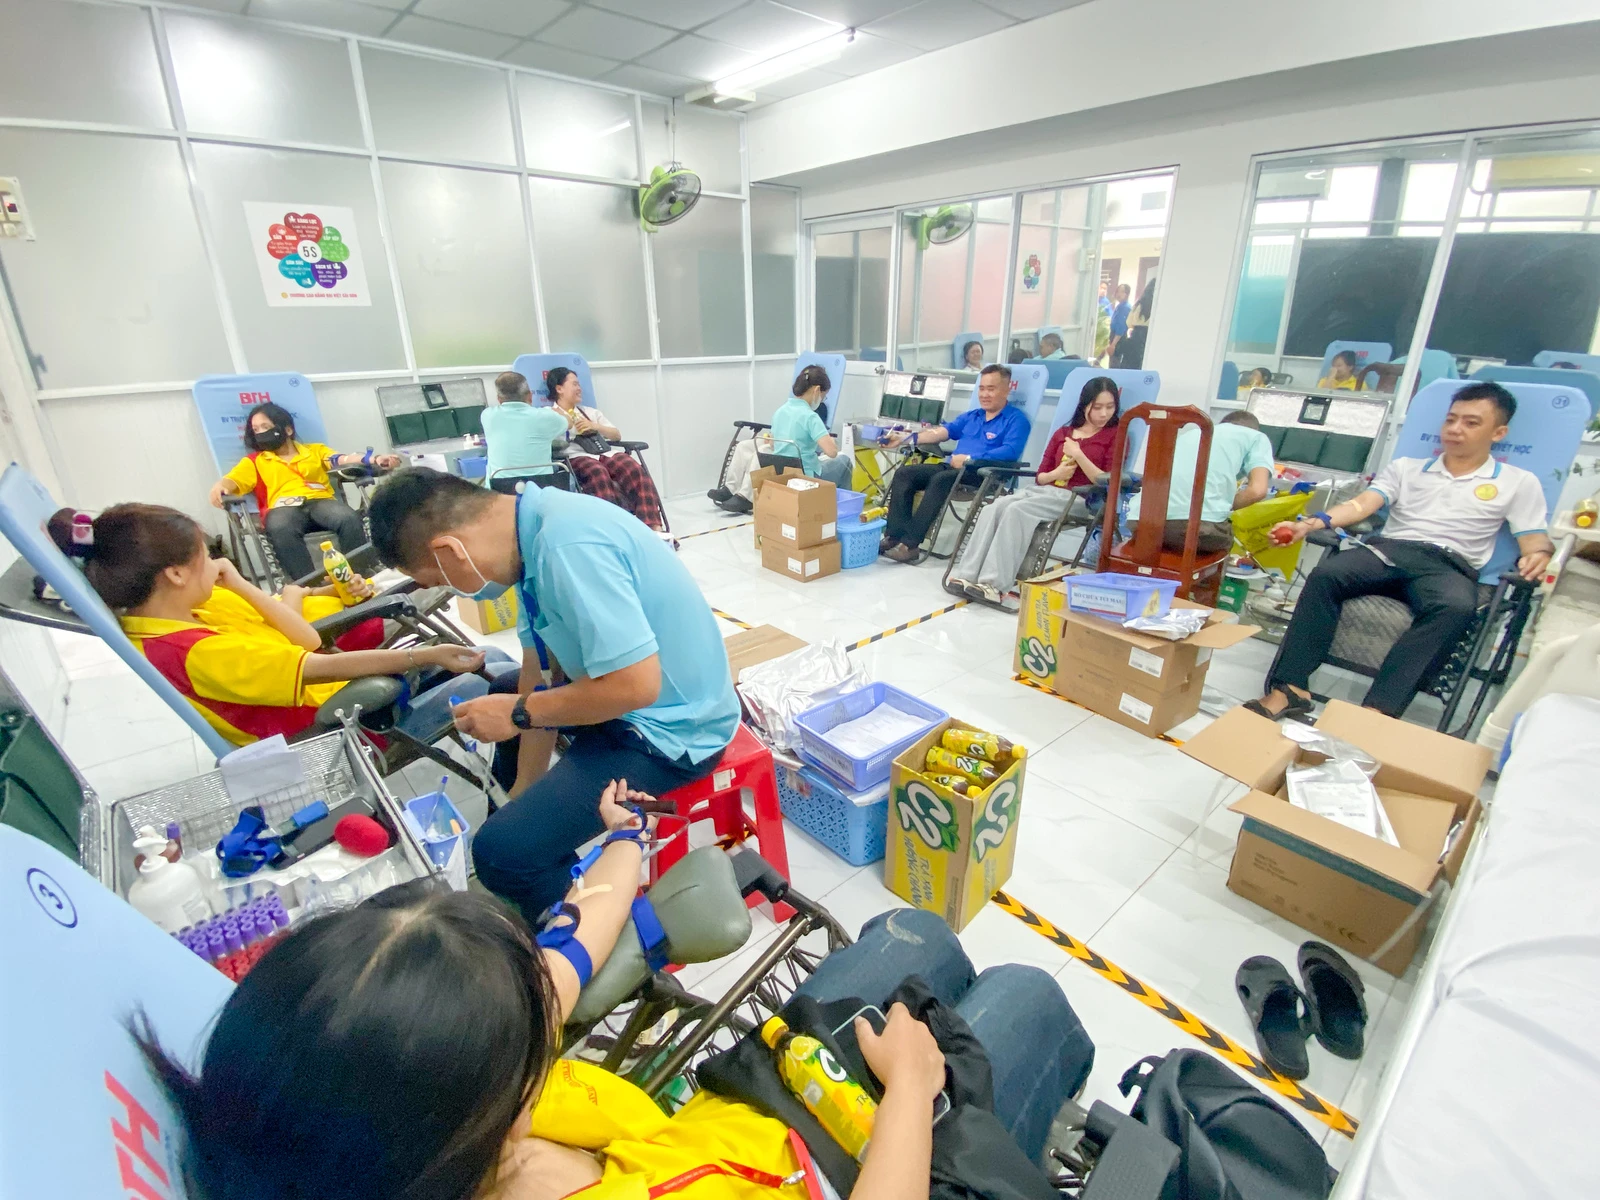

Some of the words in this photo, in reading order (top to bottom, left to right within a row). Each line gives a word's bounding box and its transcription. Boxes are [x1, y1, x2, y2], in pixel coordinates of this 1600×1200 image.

[302, 246, 317, 258] 5S
[239, 391, 271, 405] BTH
[1420, 433, 1430, 442] BV
[1513, 444, 1533, 454] HỌC
[1023, 637, 1056, 678] C2
[897, 781, 951, 849] C2
[975, 780, 1017, 861] C2
[38, 883, 64, 910] 3
[819, 1048, 847, 1082] C
[104, 1069, 171, 1200] TH
